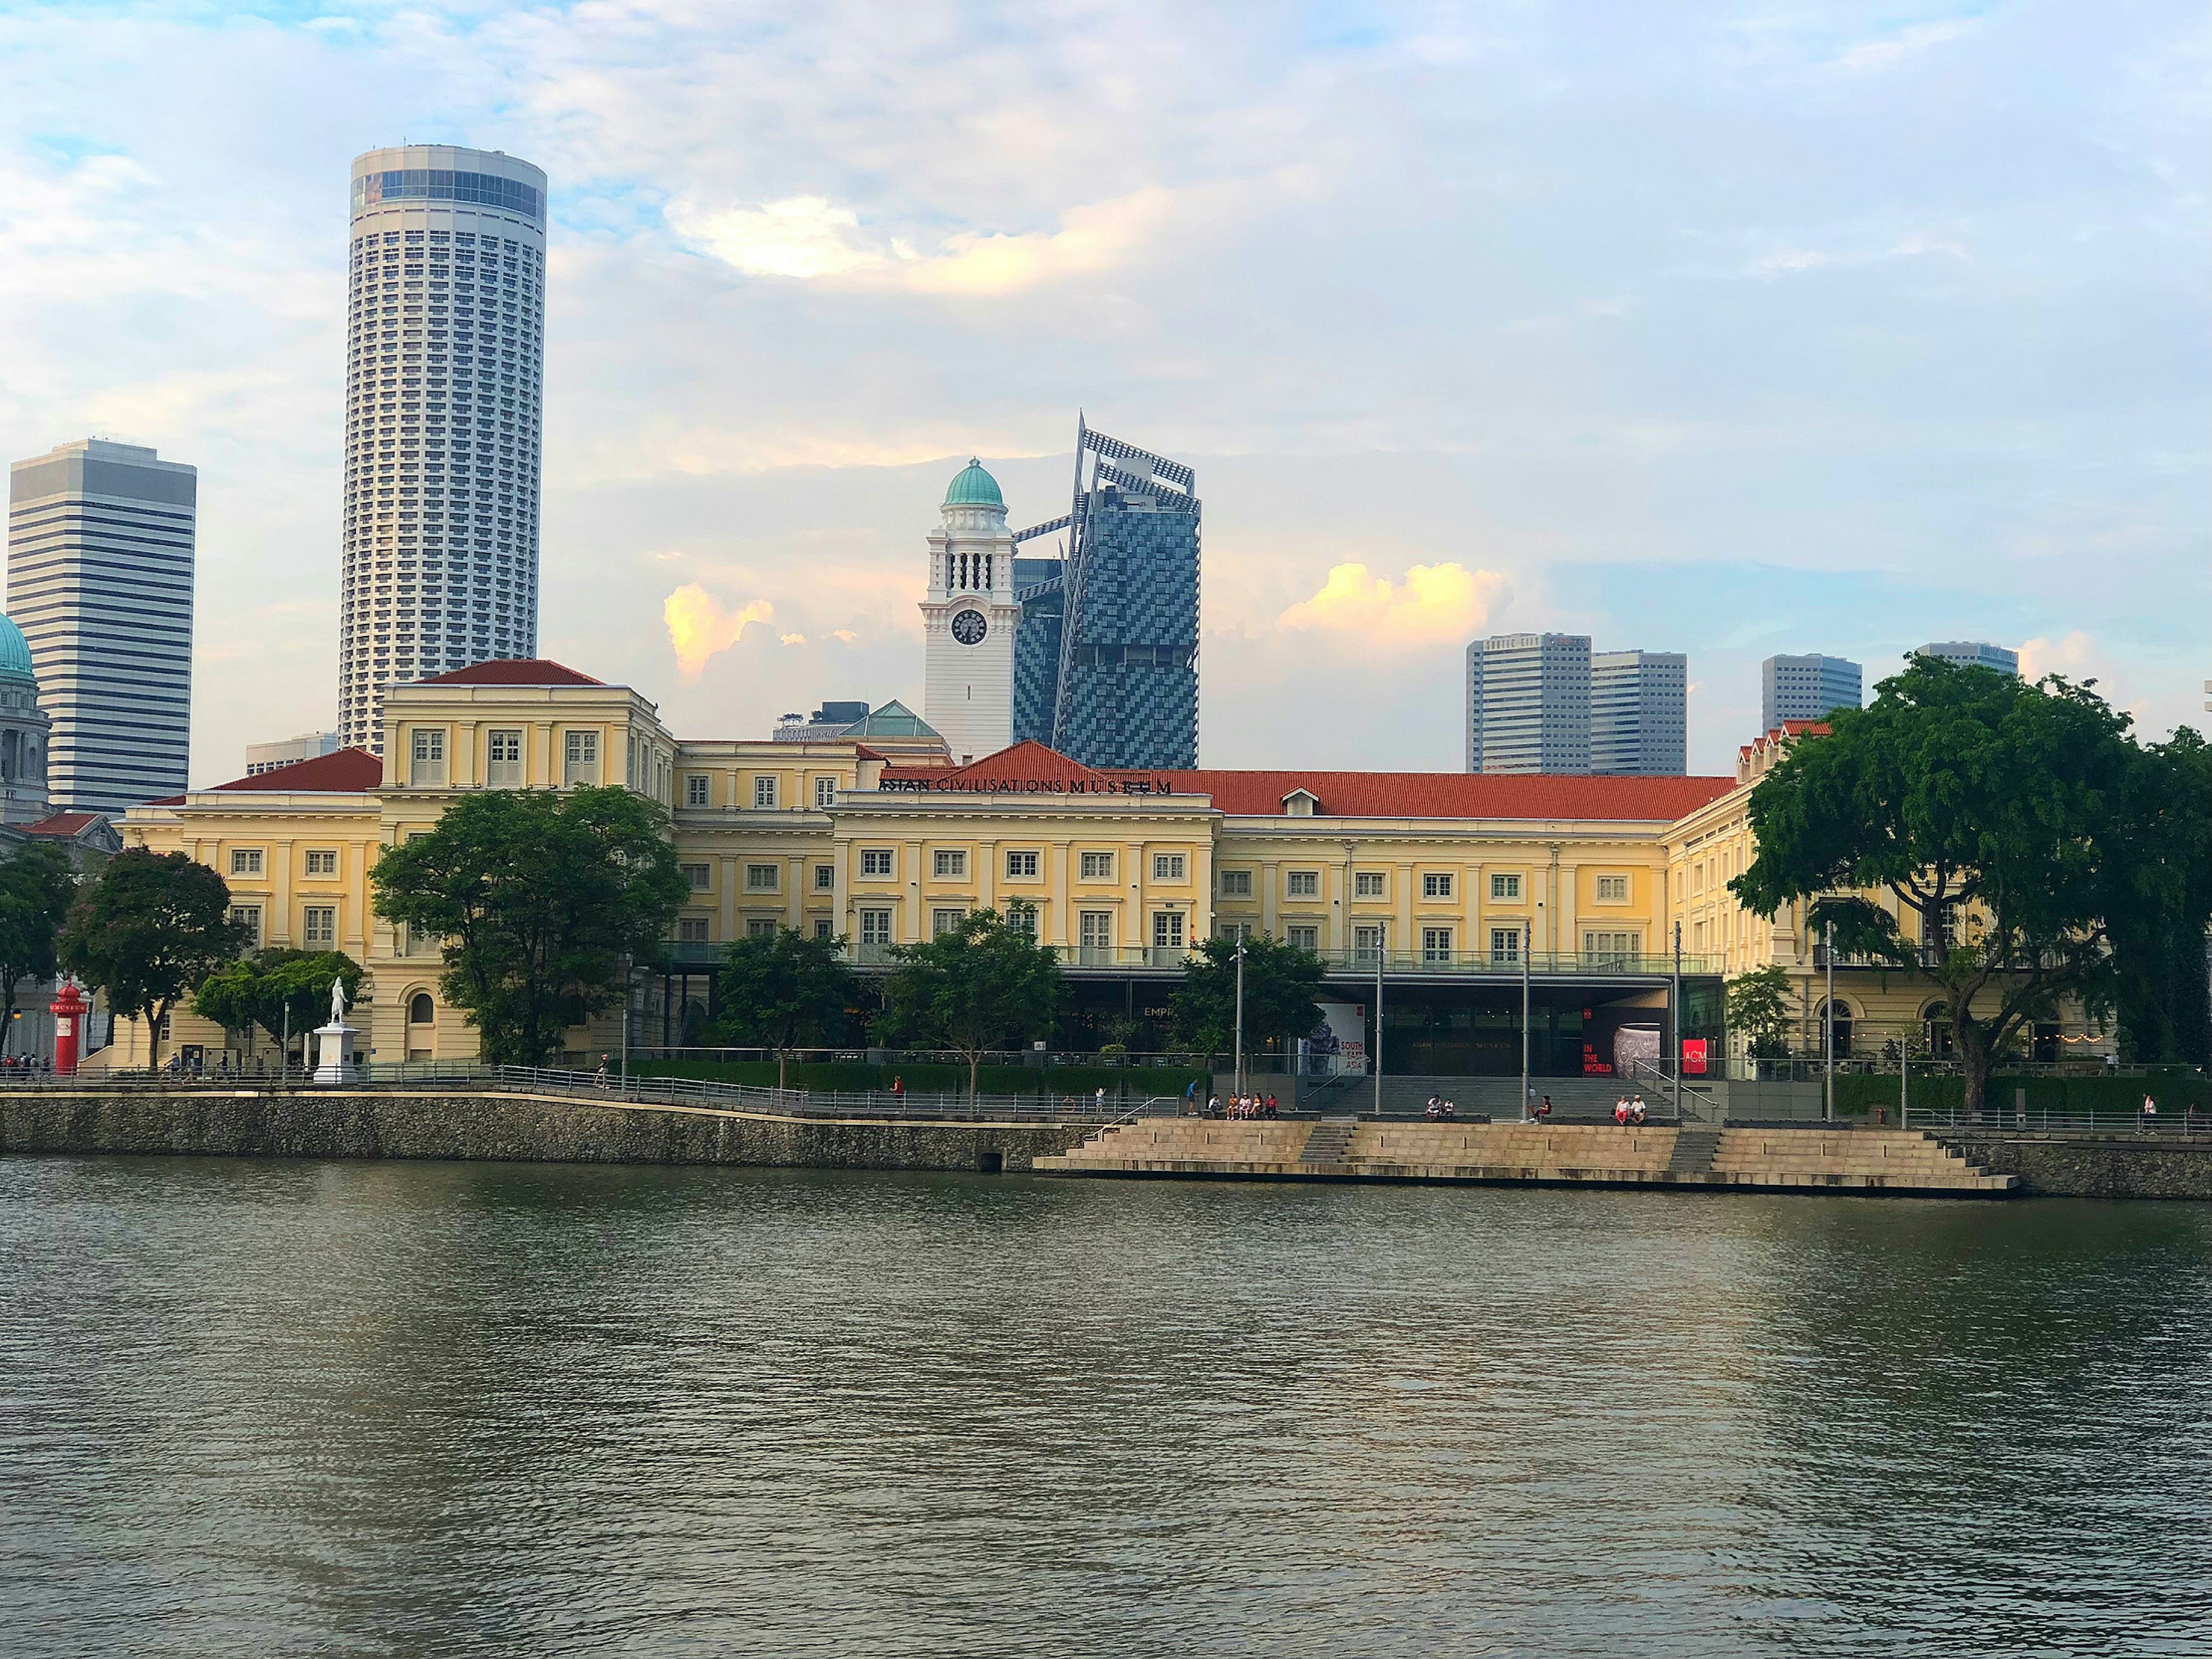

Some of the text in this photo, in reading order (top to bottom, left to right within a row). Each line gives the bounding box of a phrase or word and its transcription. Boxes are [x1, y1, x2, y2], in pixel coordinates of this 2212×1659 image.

[878, 778, 1171, 794] ASIAN CIVILISATIONS MUSEUM
[1144, 1007, 1175, 1017] EMPR
[1340, 1041, 1363, 1050] SOUTH
[1584, 1044, 1592, 1052] IN
[1584, 1054, 1597, 1062] THE
[1684, 1051, 1707, 1062] ACM
[1584, 1063, 1612, 1072] WORLD
